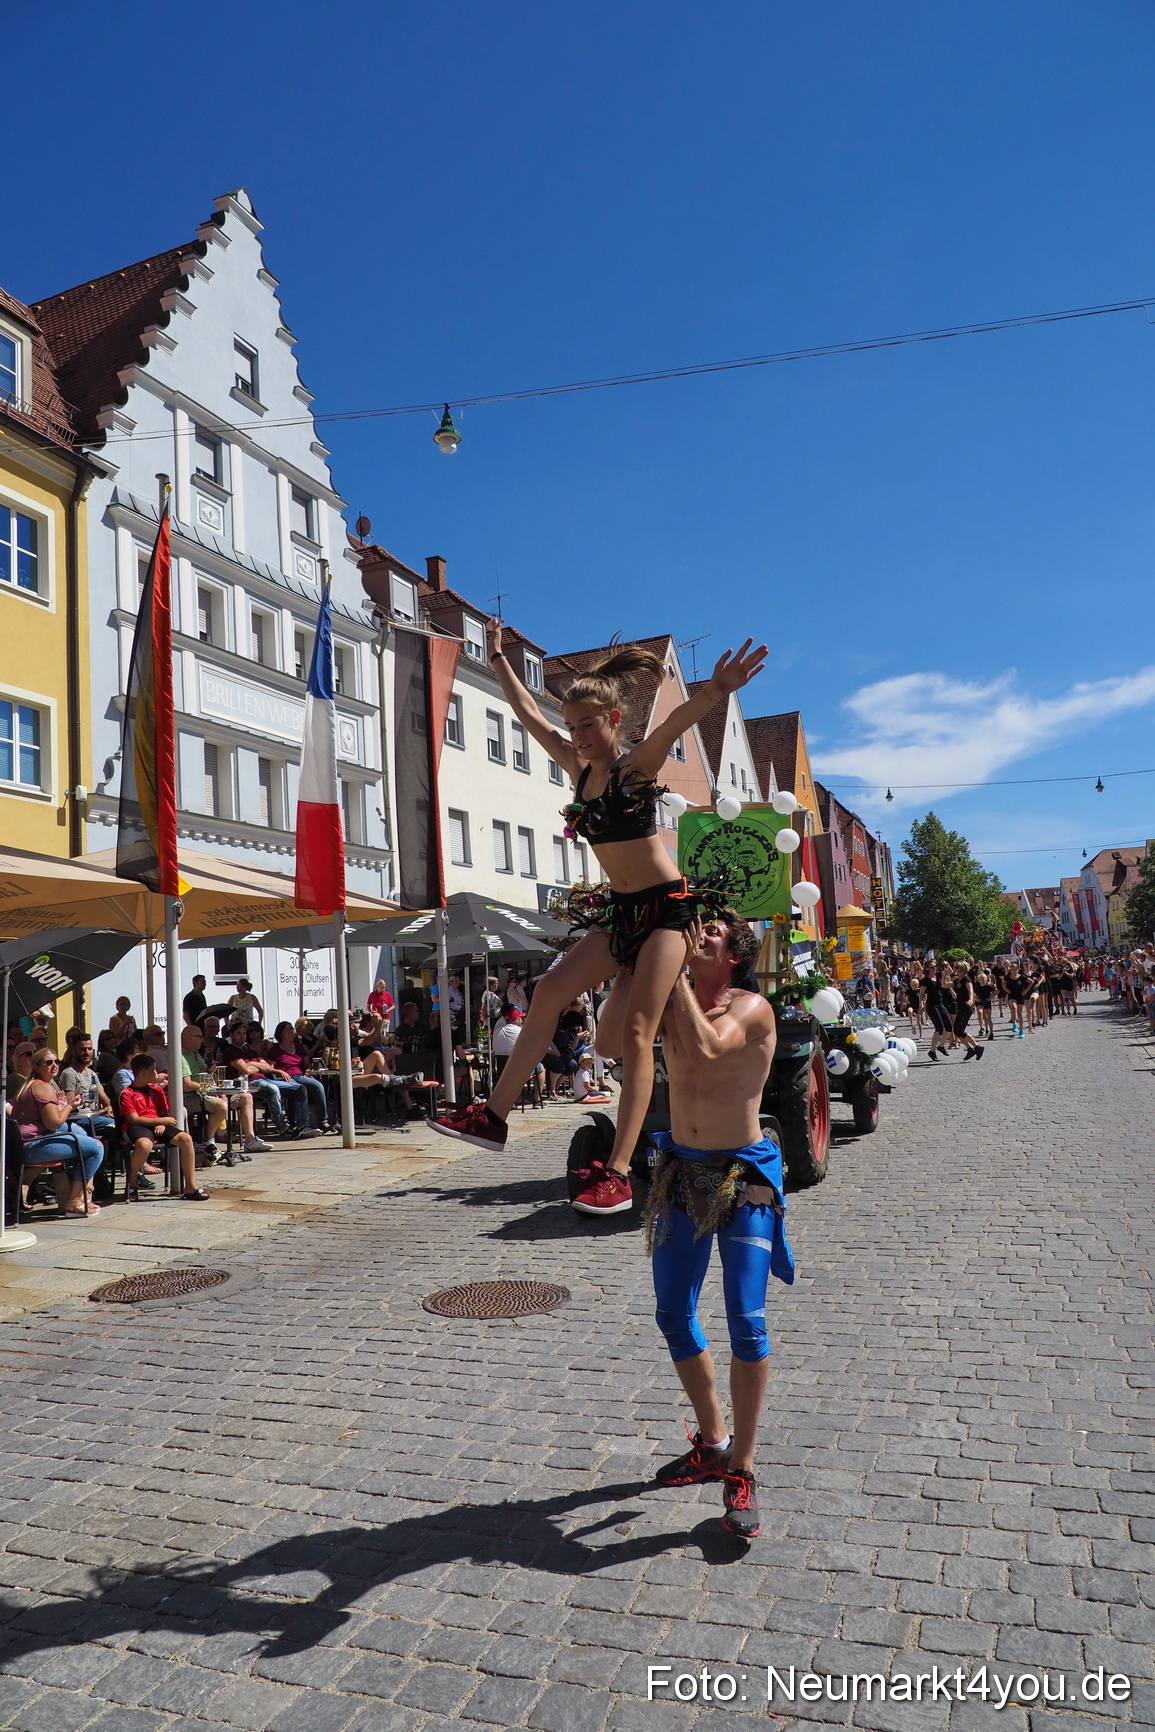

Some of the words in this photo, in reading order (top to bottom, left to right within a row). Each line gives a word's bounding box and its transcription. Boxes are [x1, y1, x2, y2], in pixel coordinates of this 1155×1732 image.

[206, 680, 265, 719] BRILLEN
[872, 879, 885, 930] HOTEL
[280, 973, 298, 985] Bang
[305, 973, 329, 983] Olufsen
[294, 987, 325, 997] Numarkt
